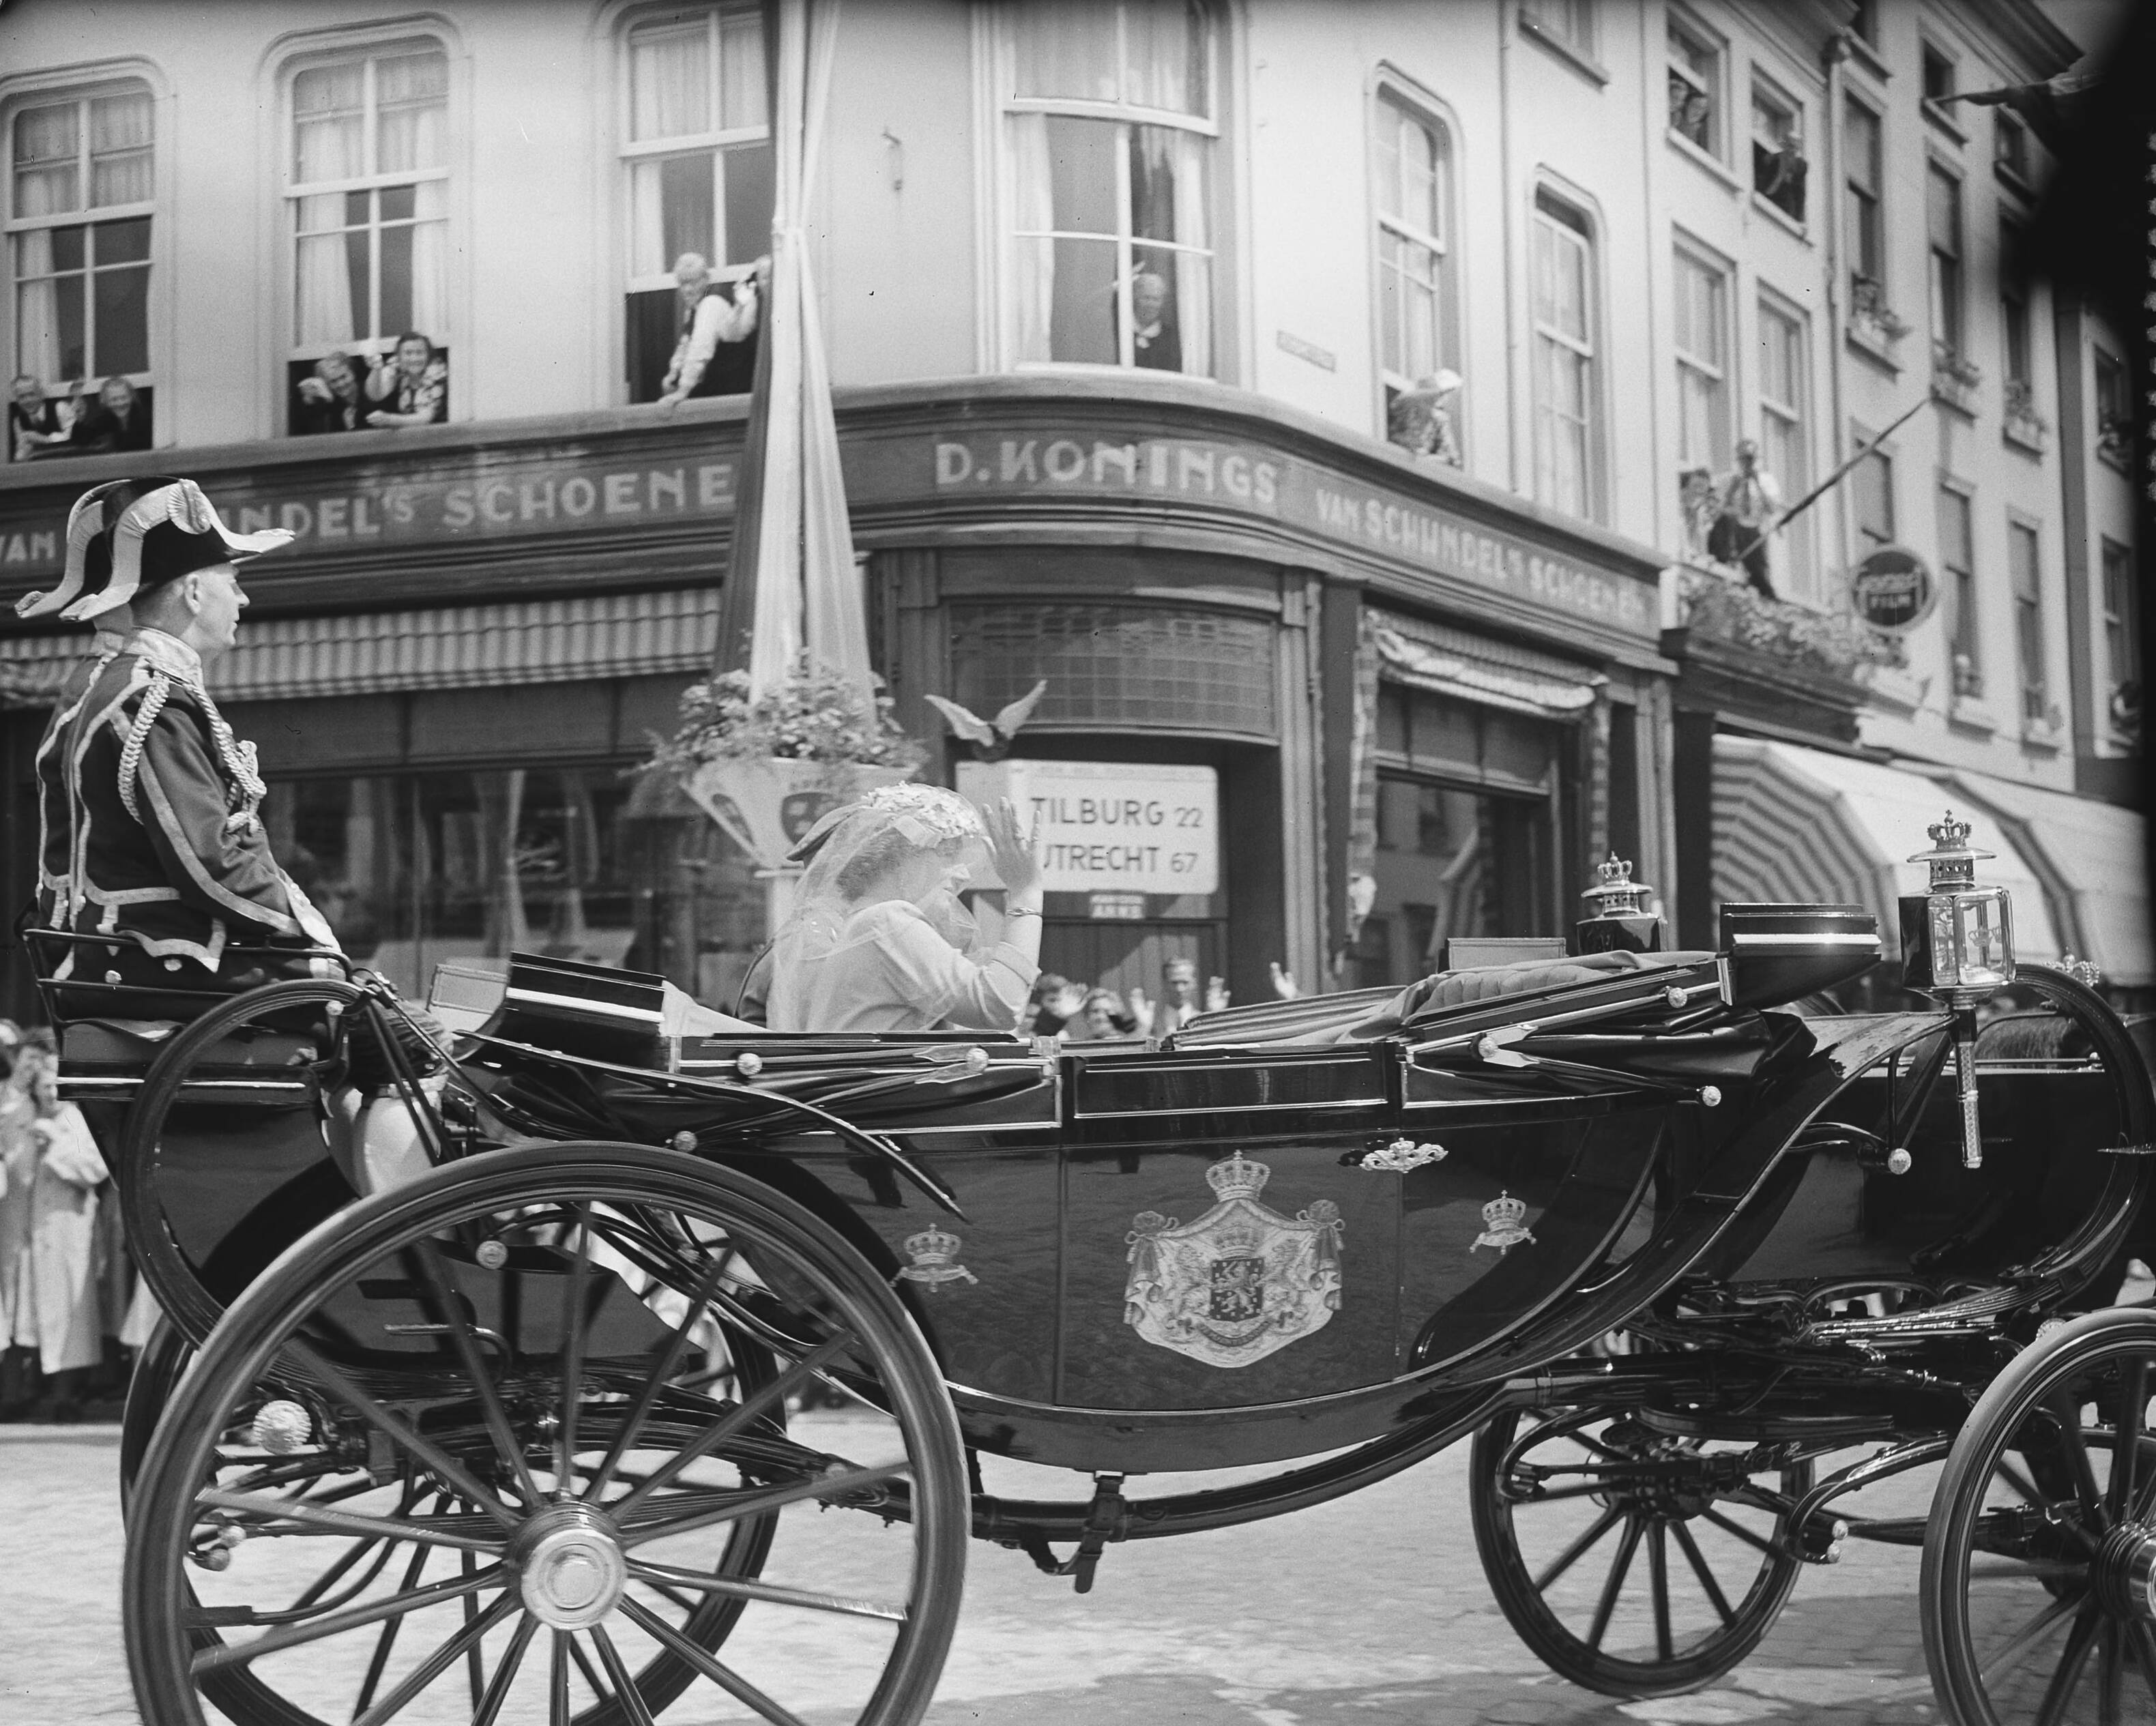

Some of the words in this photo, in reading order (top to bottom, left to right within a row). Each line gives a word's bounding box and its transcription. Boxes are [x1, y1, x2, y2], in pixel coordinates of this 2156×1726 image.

[0, 529, 56, 563] AN
[442, 464, 736, 527] SCHOENE
[1316, 488, 1360, 533] VAN
[1030, 797, 1164, 825] TILBURG
[1174, 807, 1203, 828] 22
[1170, 851, 1199, 873] 67
